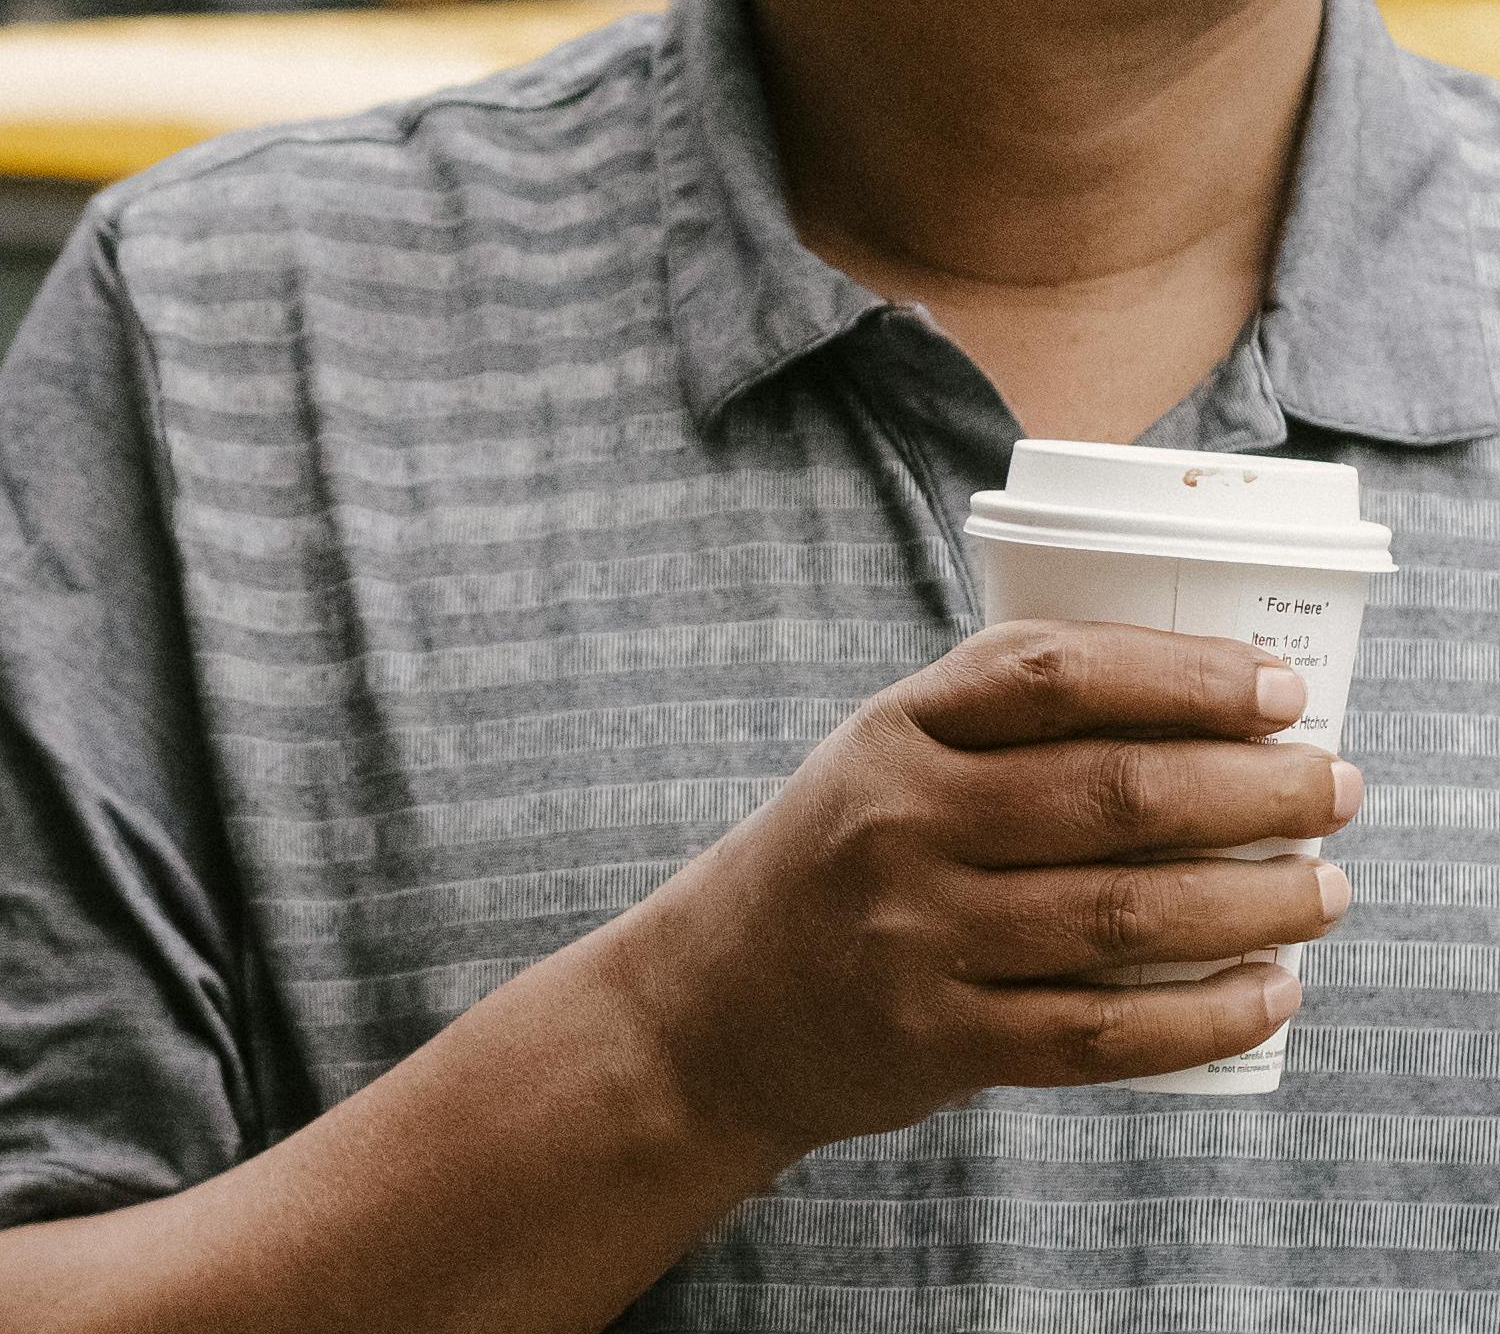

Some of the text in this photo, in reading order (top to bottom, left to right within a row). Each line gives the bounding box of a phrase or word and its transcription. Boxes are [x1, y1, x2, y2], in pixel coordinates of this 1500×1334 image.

[1267, 597, 1322, 615] For Here
[1283, 634, 1288, 647] 1
[1291, 635, 1302, 648] of
[1303, 635, 1310, 649] 3
[1323, 654, 1328, 667] 3
[1207, 1064, 1220, 1073] Do
[1222, 1064, 1235, 1074] not
